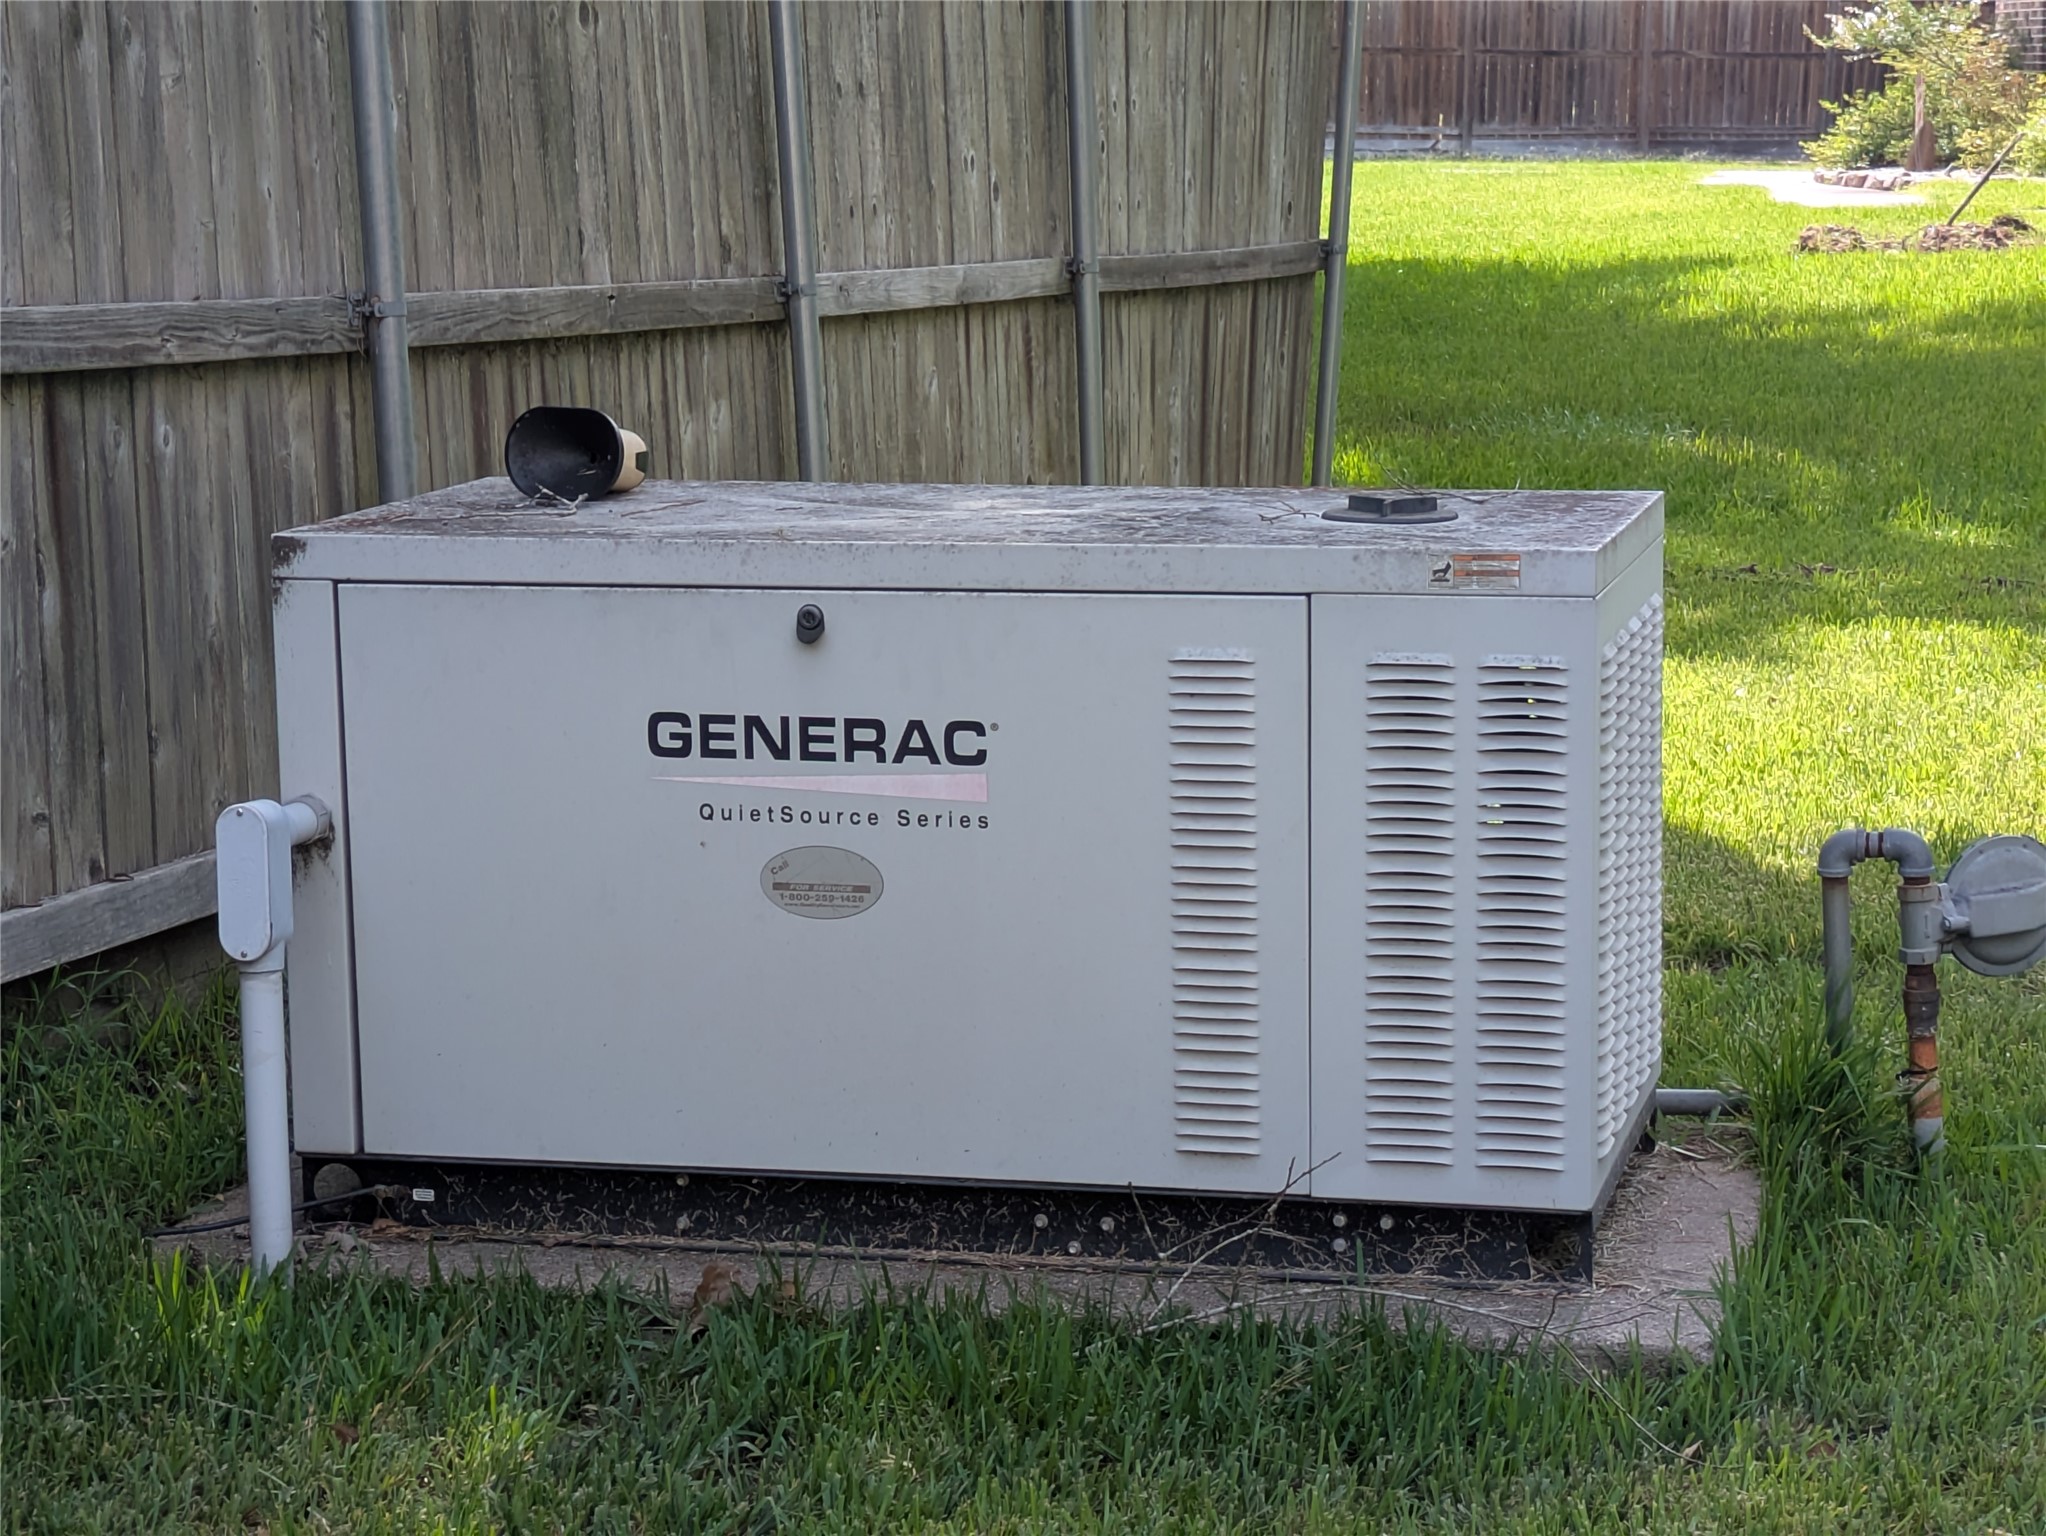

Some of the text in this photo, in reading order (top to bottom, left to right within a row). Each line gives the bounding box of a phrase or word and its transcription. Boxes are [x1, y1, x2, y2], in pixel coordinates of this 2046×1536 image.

[648, 711, 987, 766] GENERAC
[700, 803, 989, 829] QuietSource Series
[770, 860, 789, 875] Call
